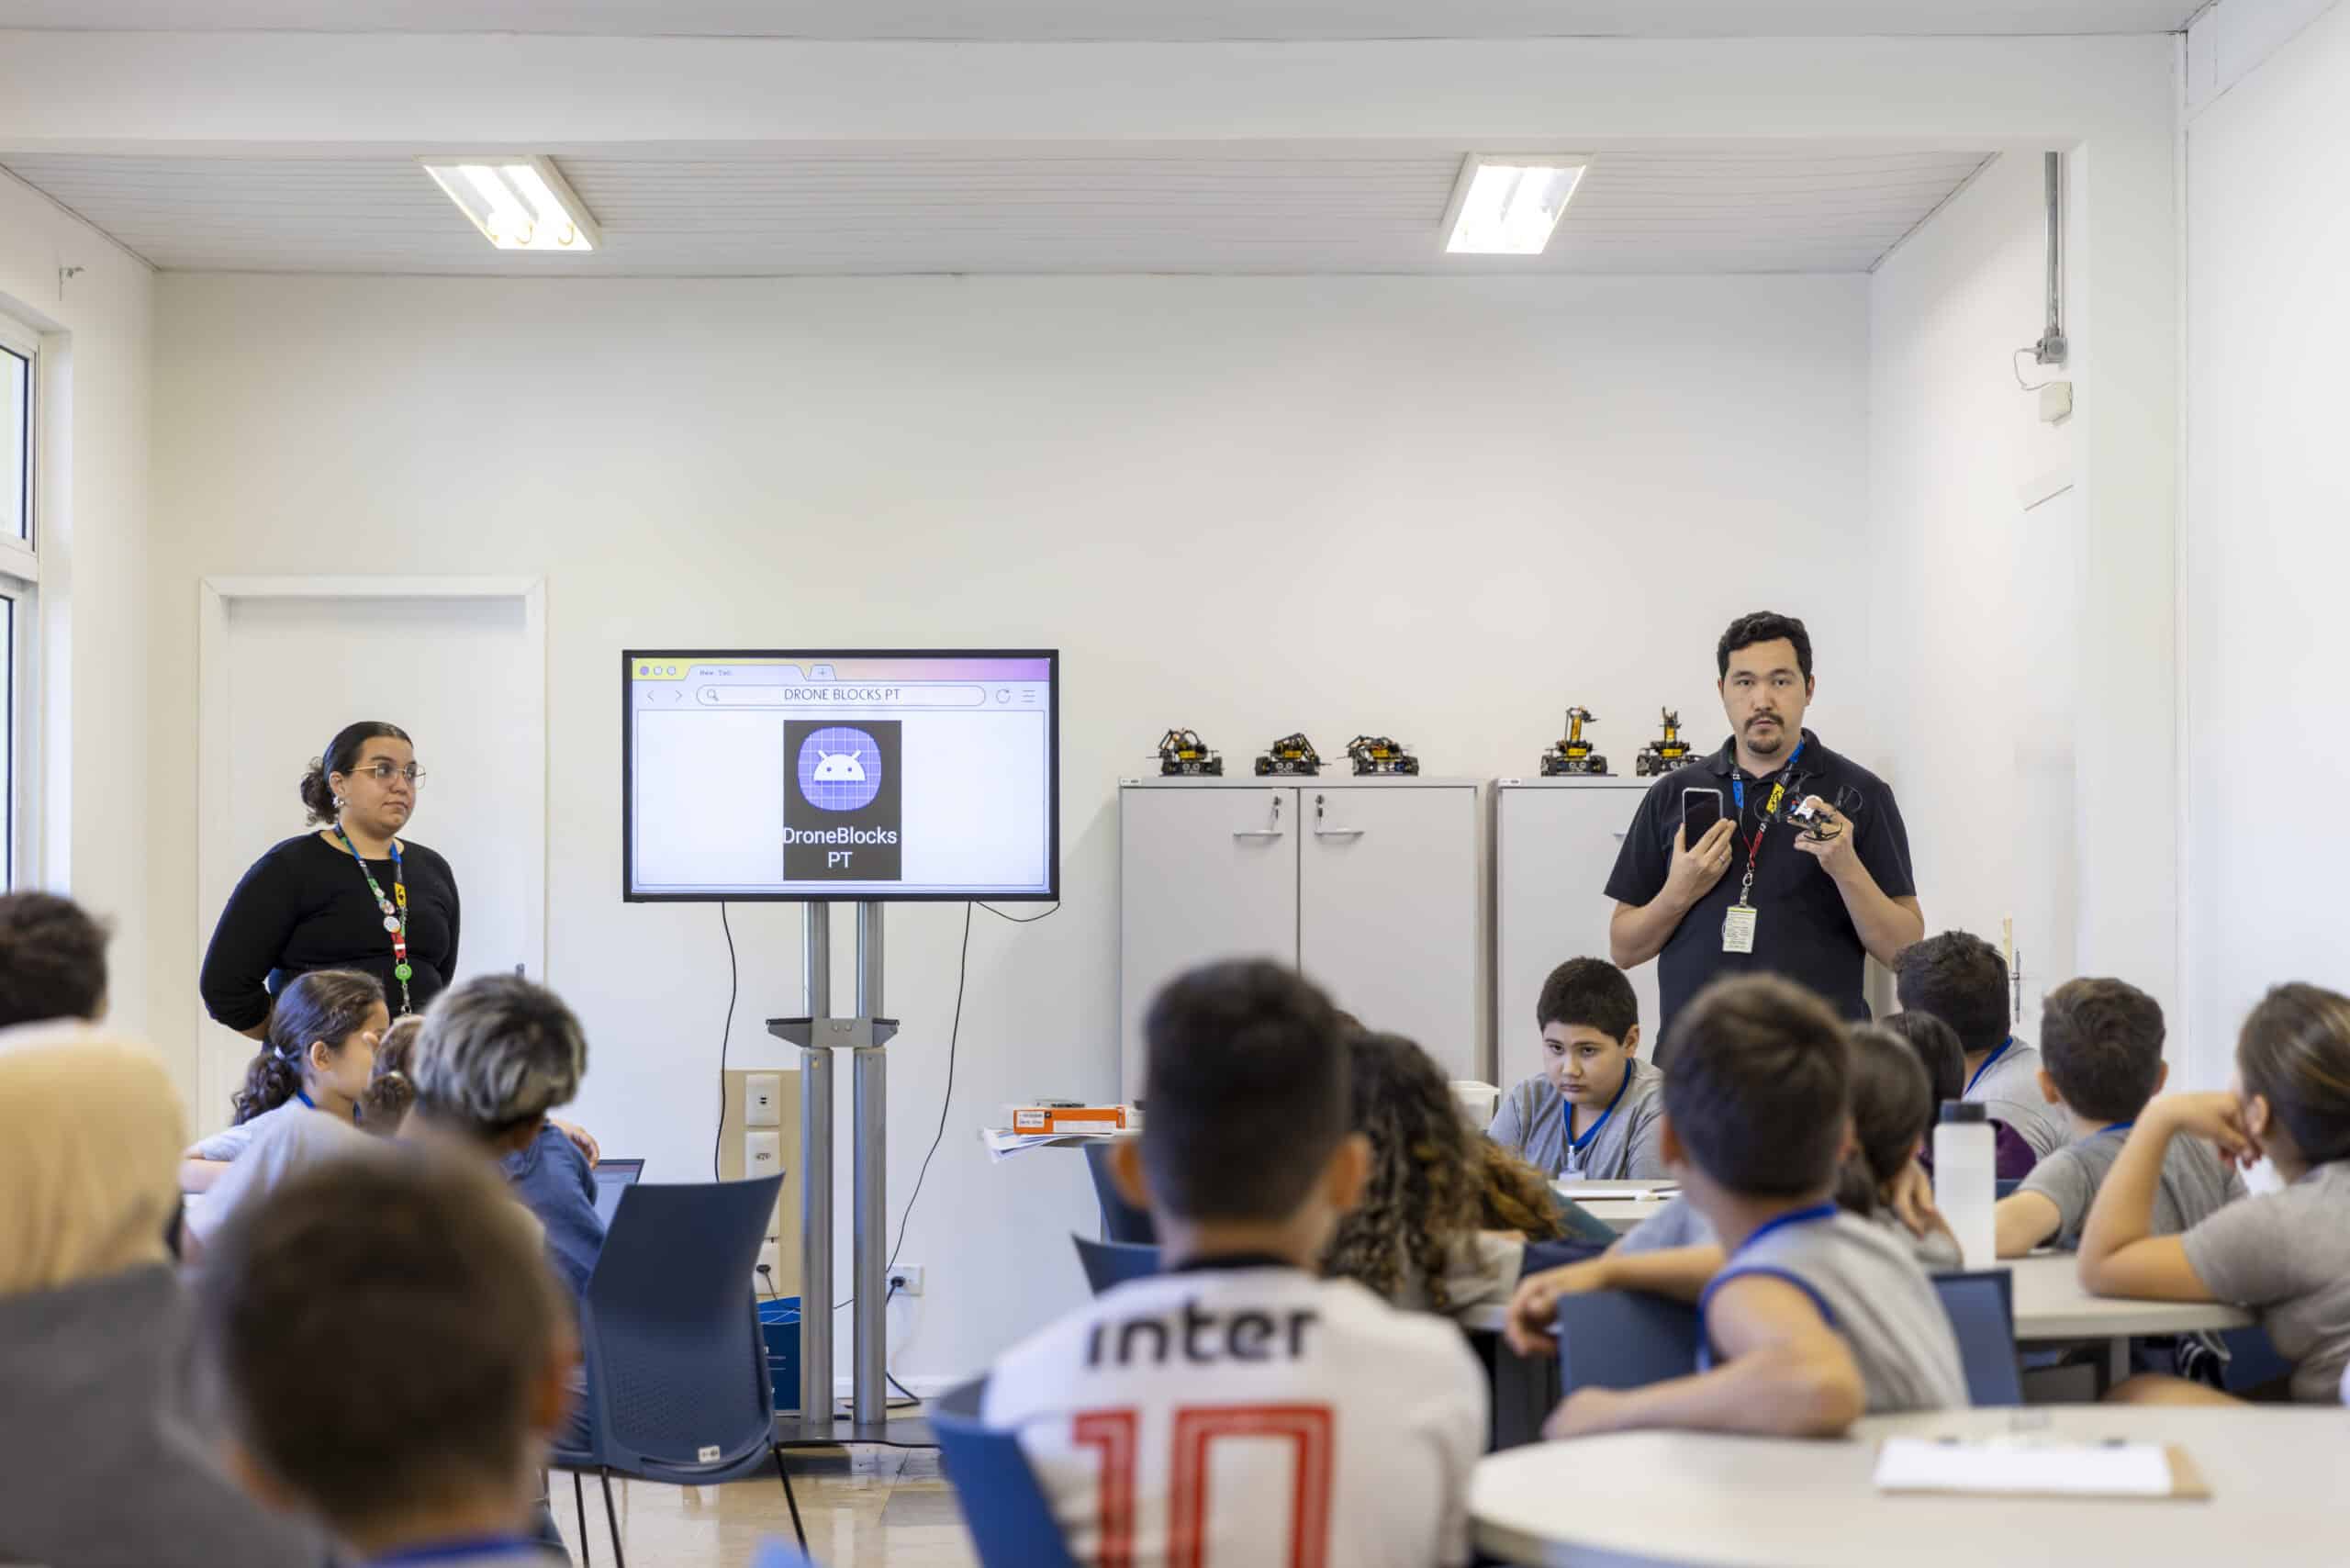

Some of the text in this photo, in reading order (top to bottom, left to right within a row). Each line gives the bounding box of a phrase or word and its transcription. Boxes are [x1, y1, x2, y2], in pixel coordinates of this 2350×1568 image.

[784, 689, 901, 700] DRONE BLOCKS PT
[784, 825, 897, 844] DroneBlocks
[828, 851, 853, 868] PT
[1087, 1296, 1322, 1366] inter
